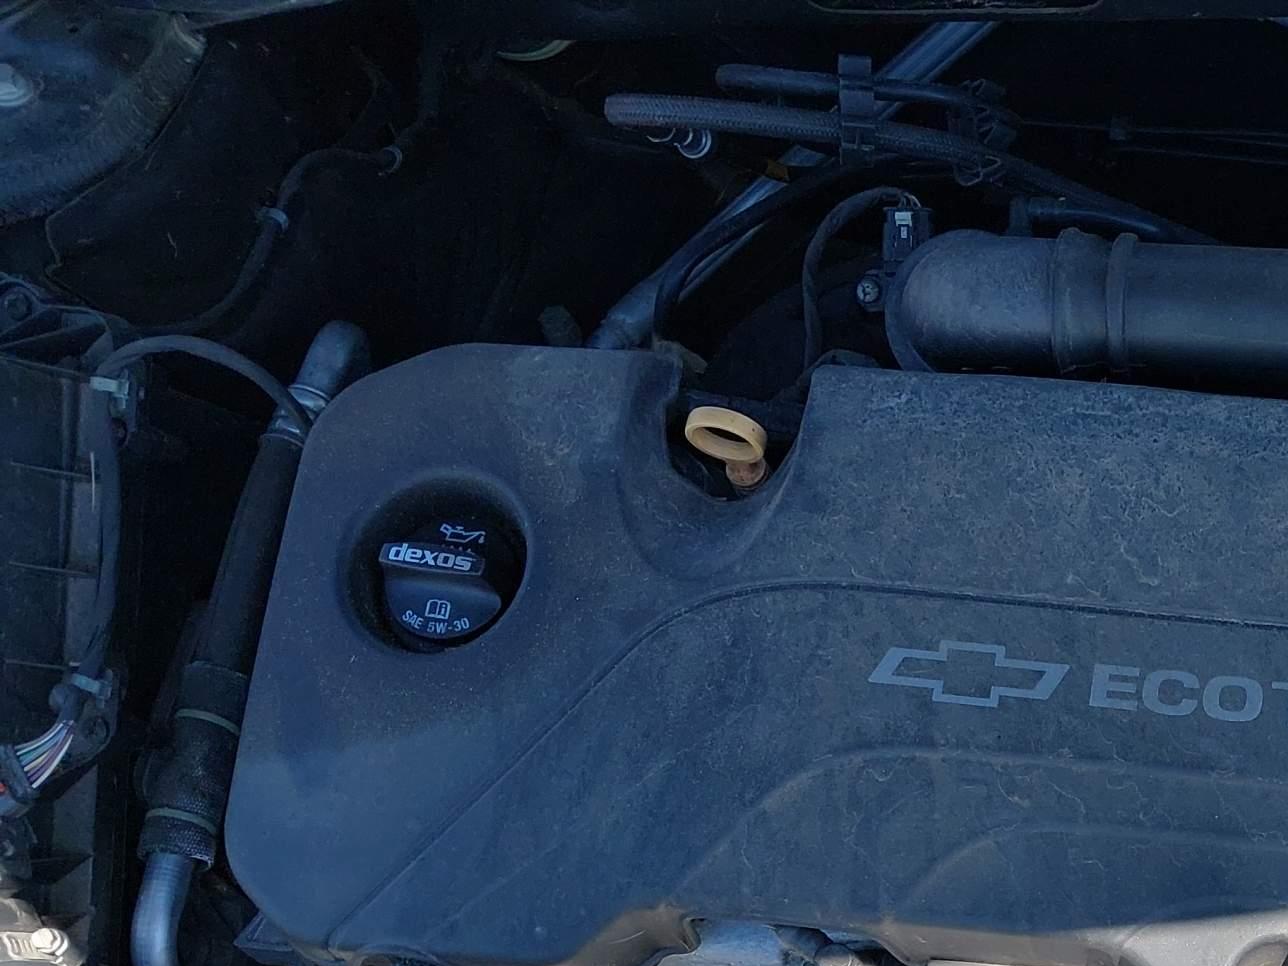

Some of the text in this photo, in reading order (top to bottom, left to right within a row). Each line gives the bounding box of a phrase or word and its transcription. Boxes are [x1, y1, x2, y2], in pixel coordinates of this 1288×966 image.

[388, 543, 473, 571] dexos
[402, 610, 470, 634] SAE 5W-30
